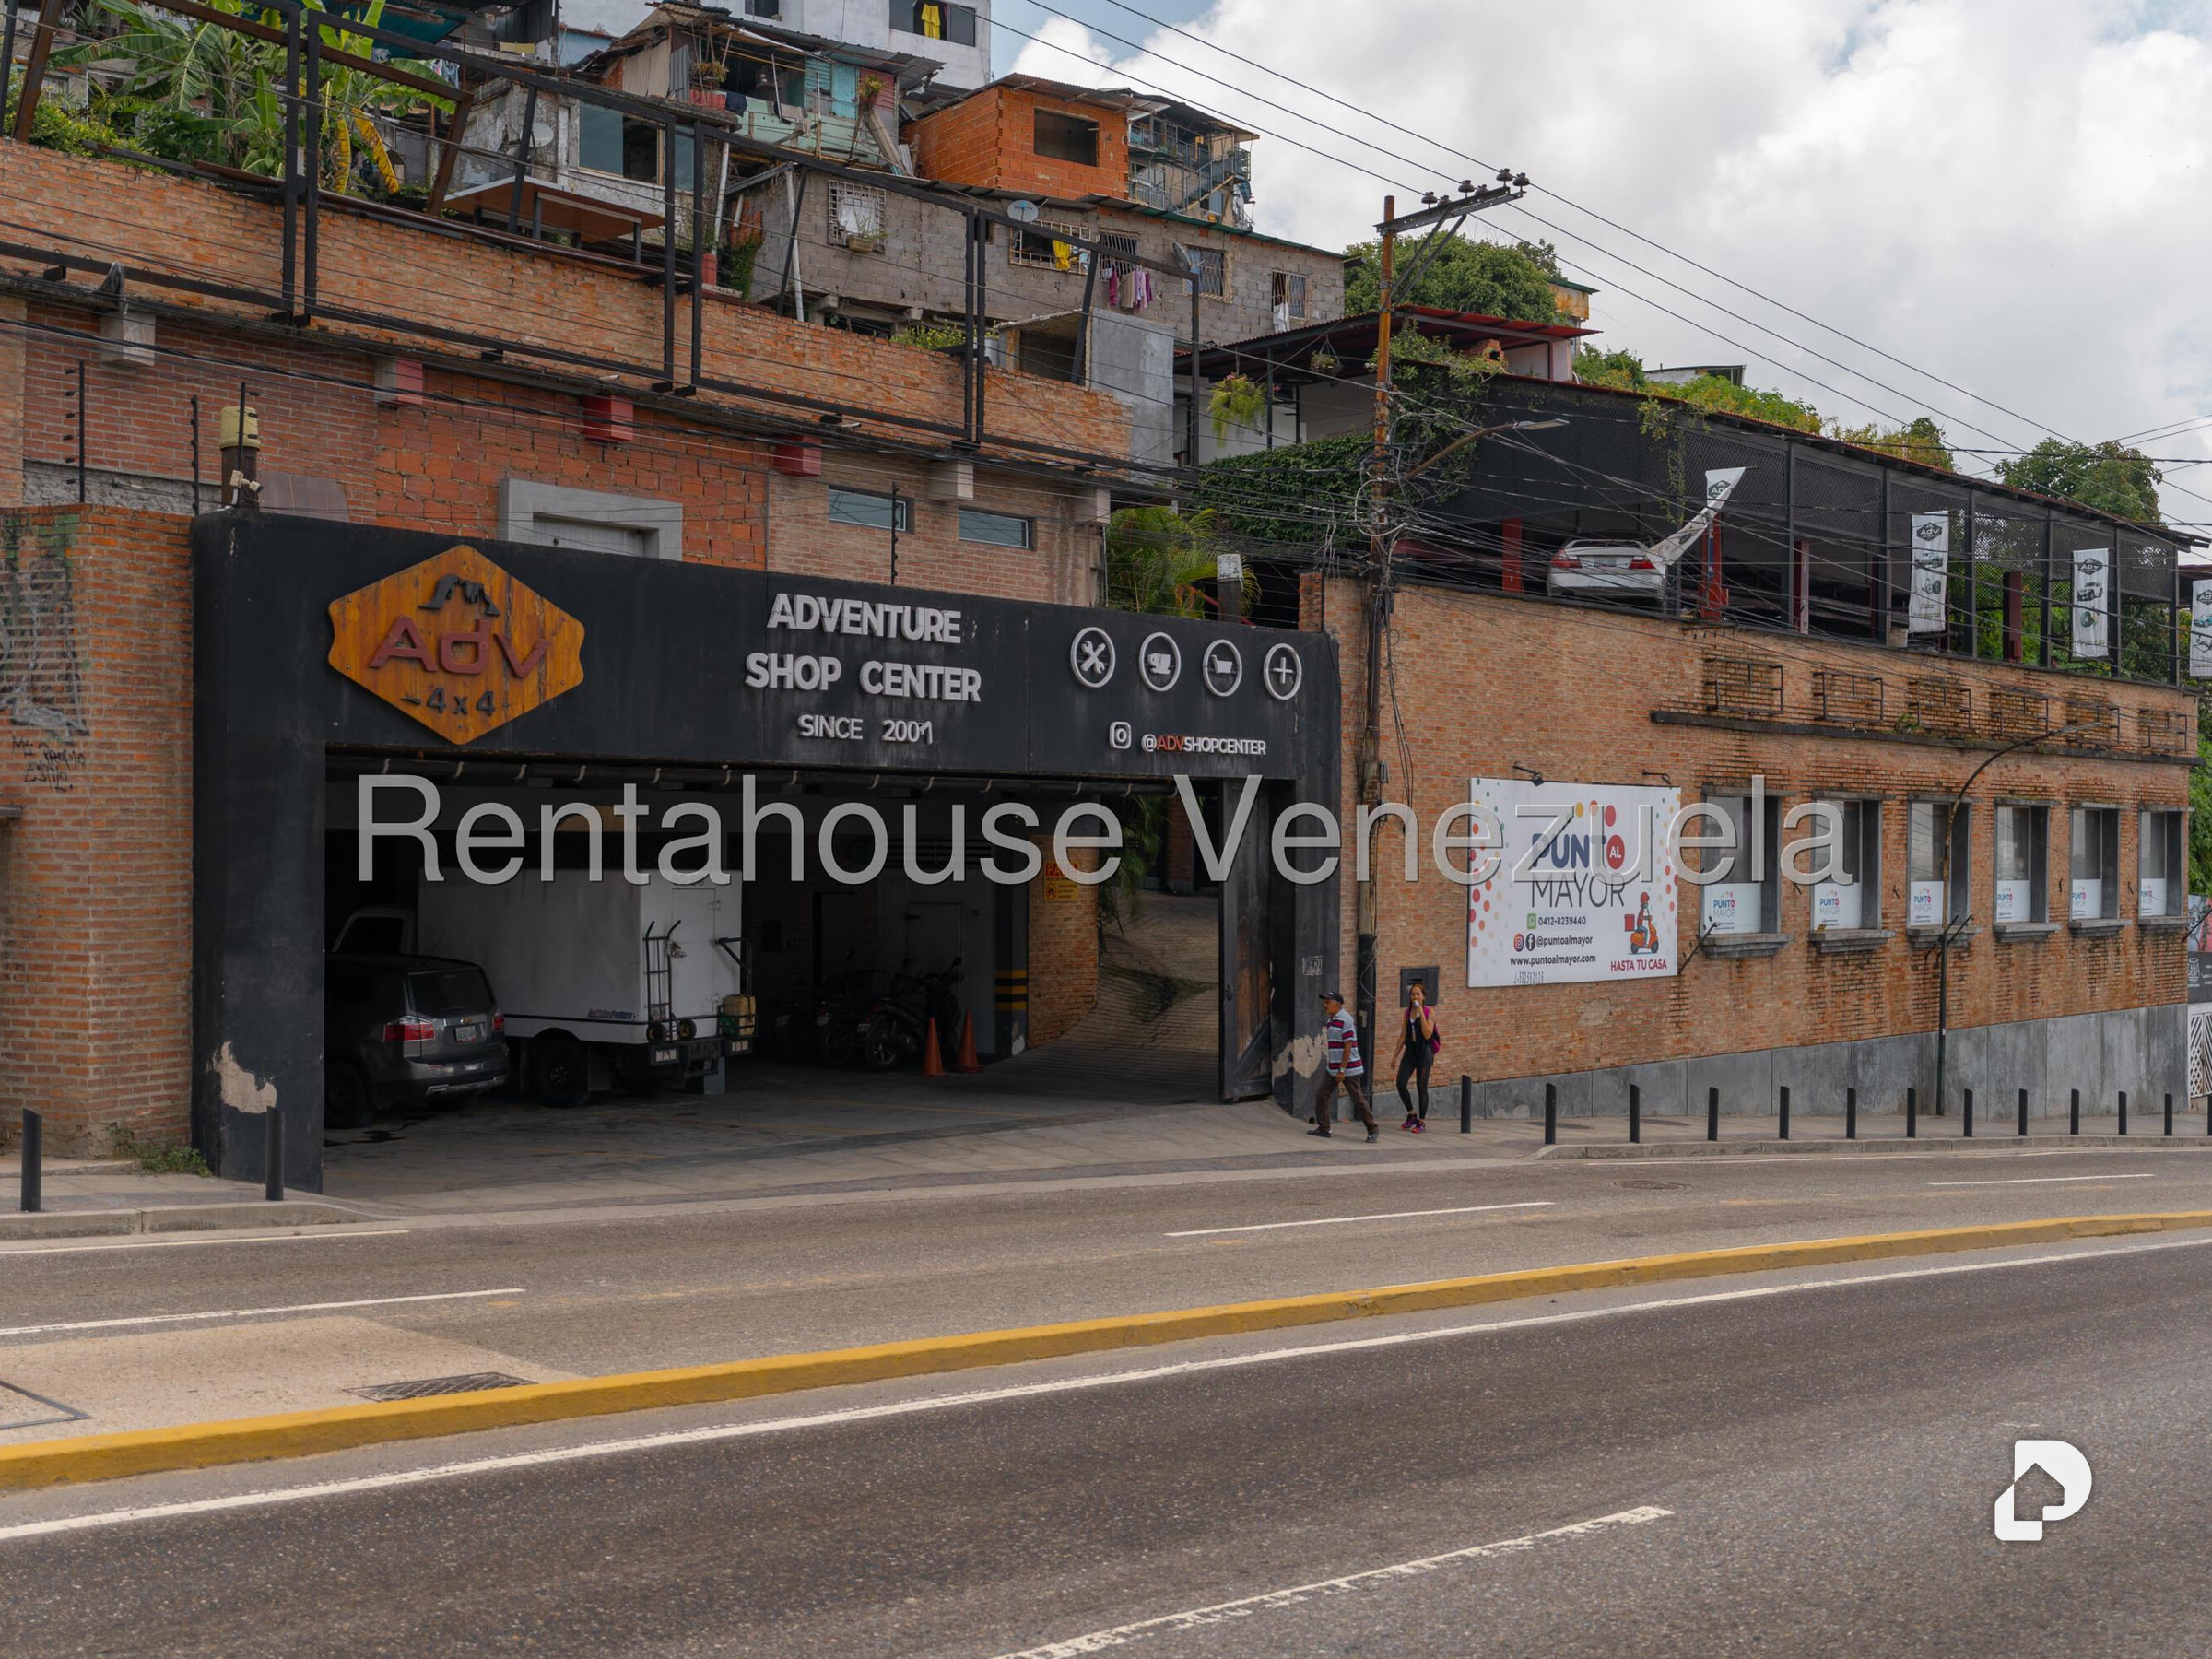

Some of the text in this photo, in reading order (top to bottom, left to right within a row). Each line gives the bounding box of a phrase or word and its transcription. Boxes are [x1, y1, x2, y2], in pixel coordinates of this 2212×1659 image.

[767, 593, 962, 644] ADVENTURE
[744, 652, 982, 702] SHOP CENTER
[797, 713, 864, 740] SINCE
[1141, 733, 1266, 756] @ADVSHOPCENTER
[1531, 873, 1626, 908] MAYOR
[1537, 916, 1587, 926] 0412-8239440
[1536, 935, 1594, 948] @puntoalmayor
[1510, 954, 1596, 967] www.puntoalmayor.com
[1610, 959, 1667, 971] HASTA TU CASA
